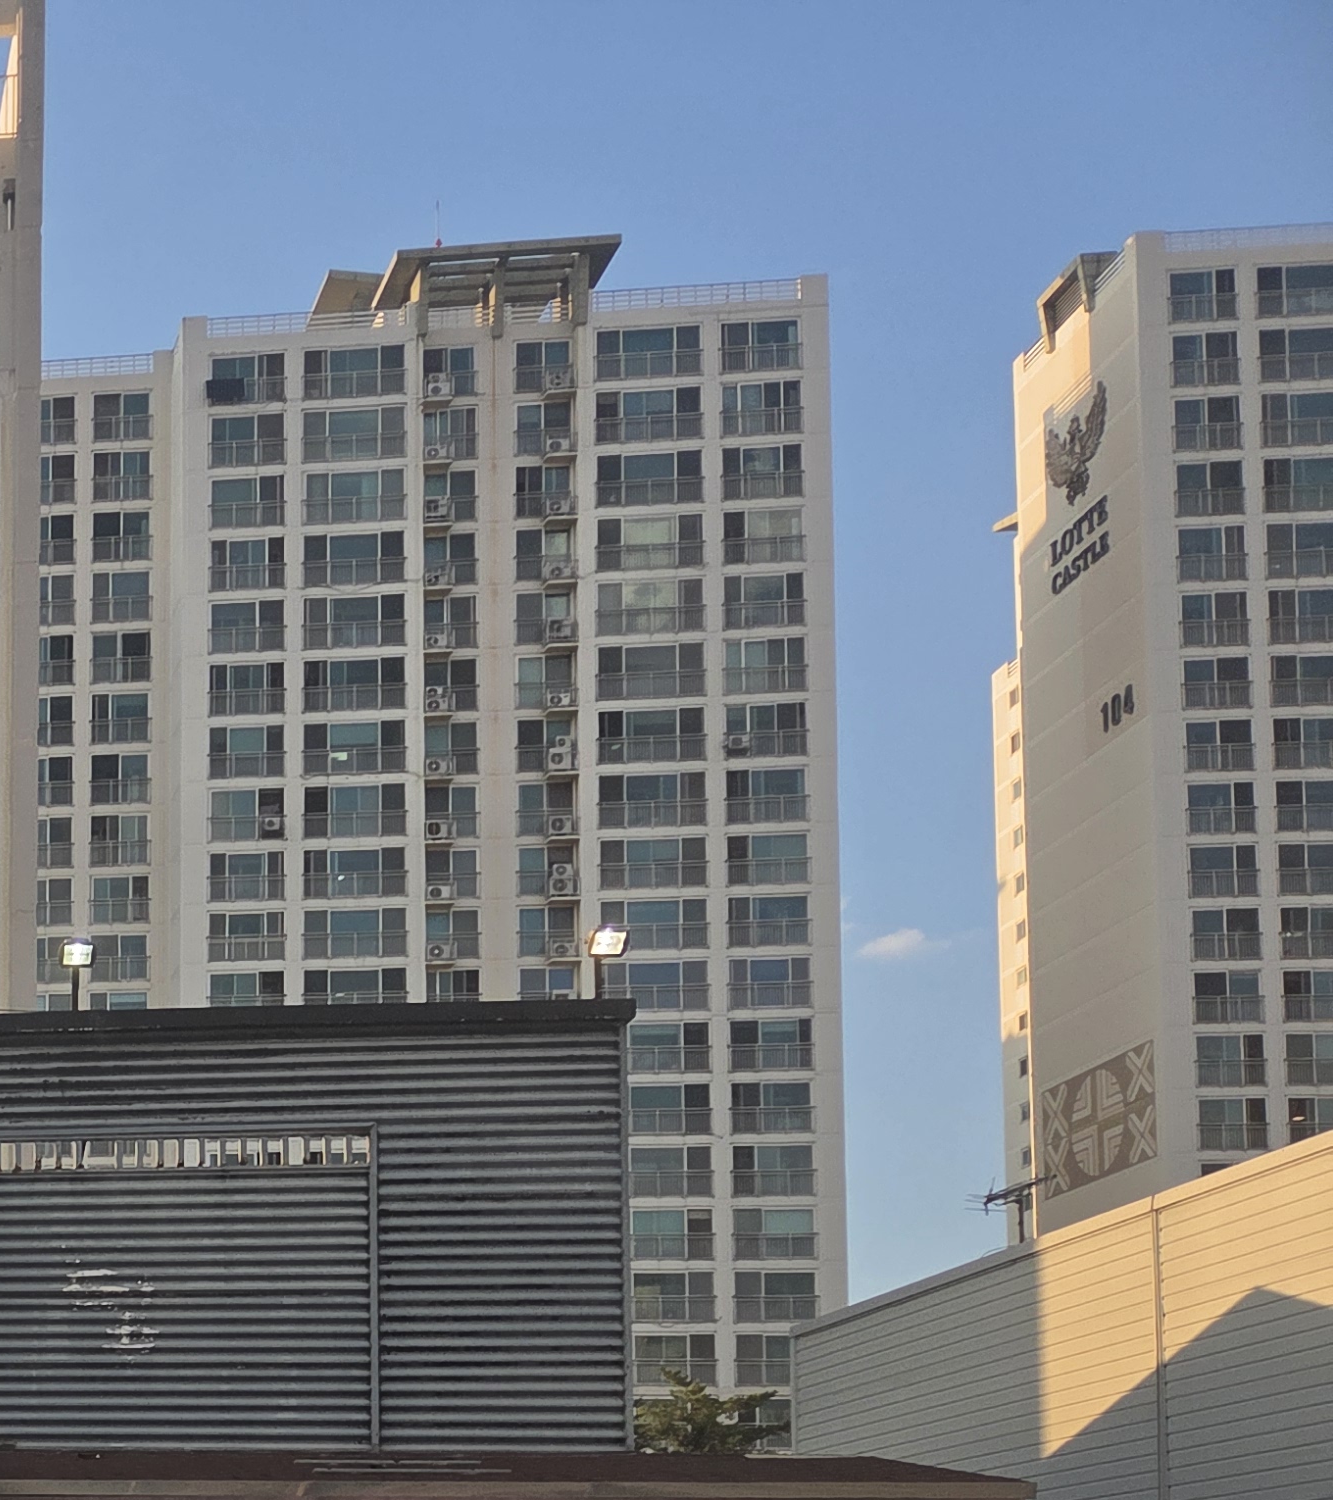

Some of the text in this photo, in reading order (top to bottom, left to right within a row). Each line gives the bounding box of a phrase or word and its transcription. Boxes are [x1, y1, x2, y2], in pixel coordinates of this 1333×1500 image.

[1049, 494, 1109, 567] LOTTE
[1051, 530, 1111, 595] CASTLE
[1100, 683, 1135, 733] 104
